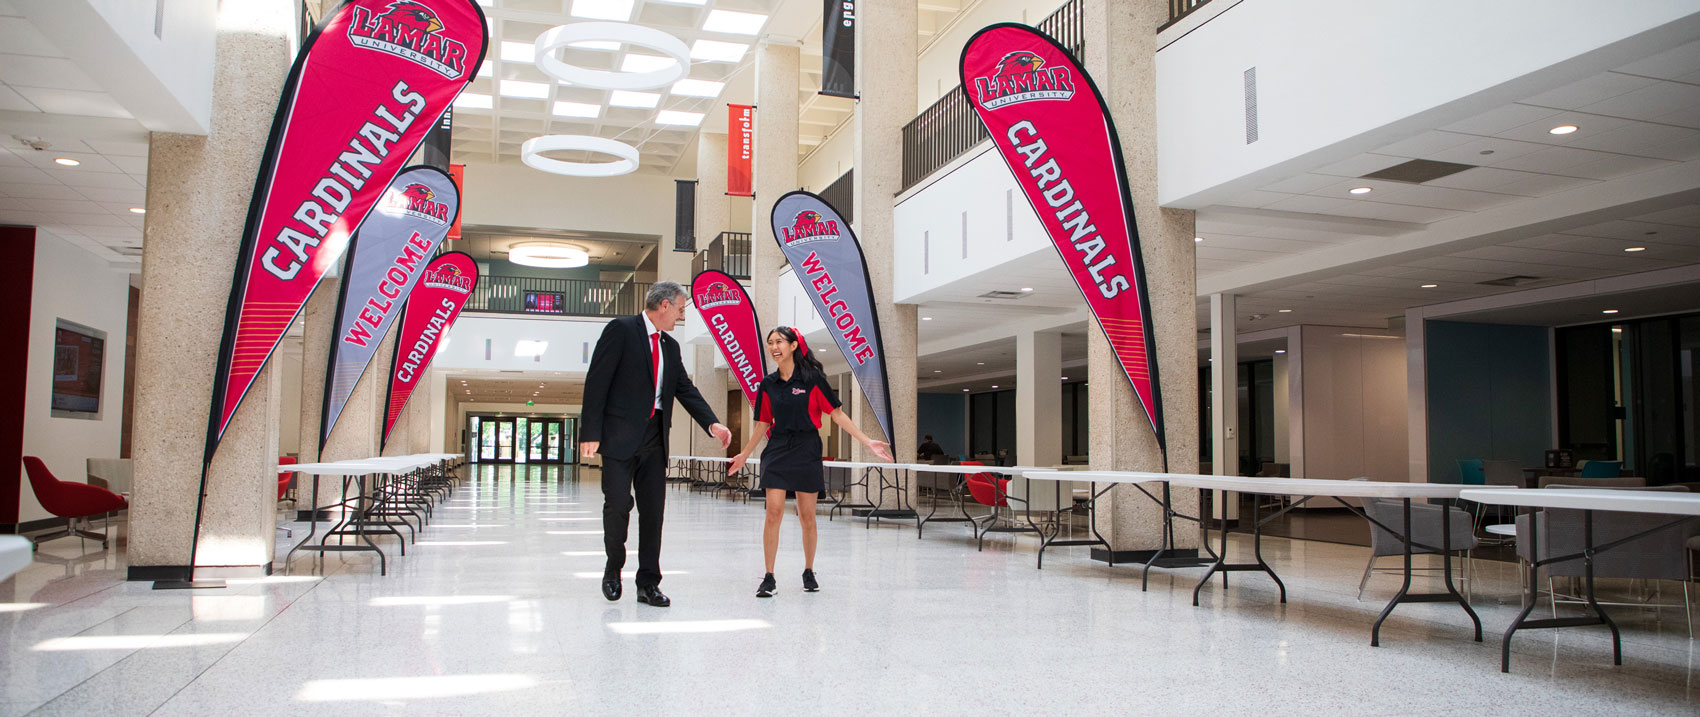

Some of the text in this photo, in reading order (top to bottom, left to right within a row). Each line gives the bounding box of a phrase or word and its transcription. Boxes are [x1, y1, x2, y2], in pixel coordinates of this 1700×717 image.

[843, 0, 855, 27] eng
[348, 5, 467, 74] LAMAR
[361, 38, 451, 75] UNIVERSITY
[976, 66, 1073, 103] LAMAR
[991, 91, 1066, 107] UNIVERSITY
[441, 106, 451, 130] inn
[739, 108, 752, 159] transform
[260, 79, 427, 281] CARDINALS
[782, 220, 840, 243] LAMAR
[1006, 119, 1131, 300] CARDINALS
[344, 231, 433, 347] WELCOME
[425, 270, 471, 290] LAMAR
[698, 288, 741, 306] LAMAR
[801, 250, 875, 365] WELCOME
[397, 297, 456, 383] CARDINALS
[711, 313, 761, 392] CARDINALS
